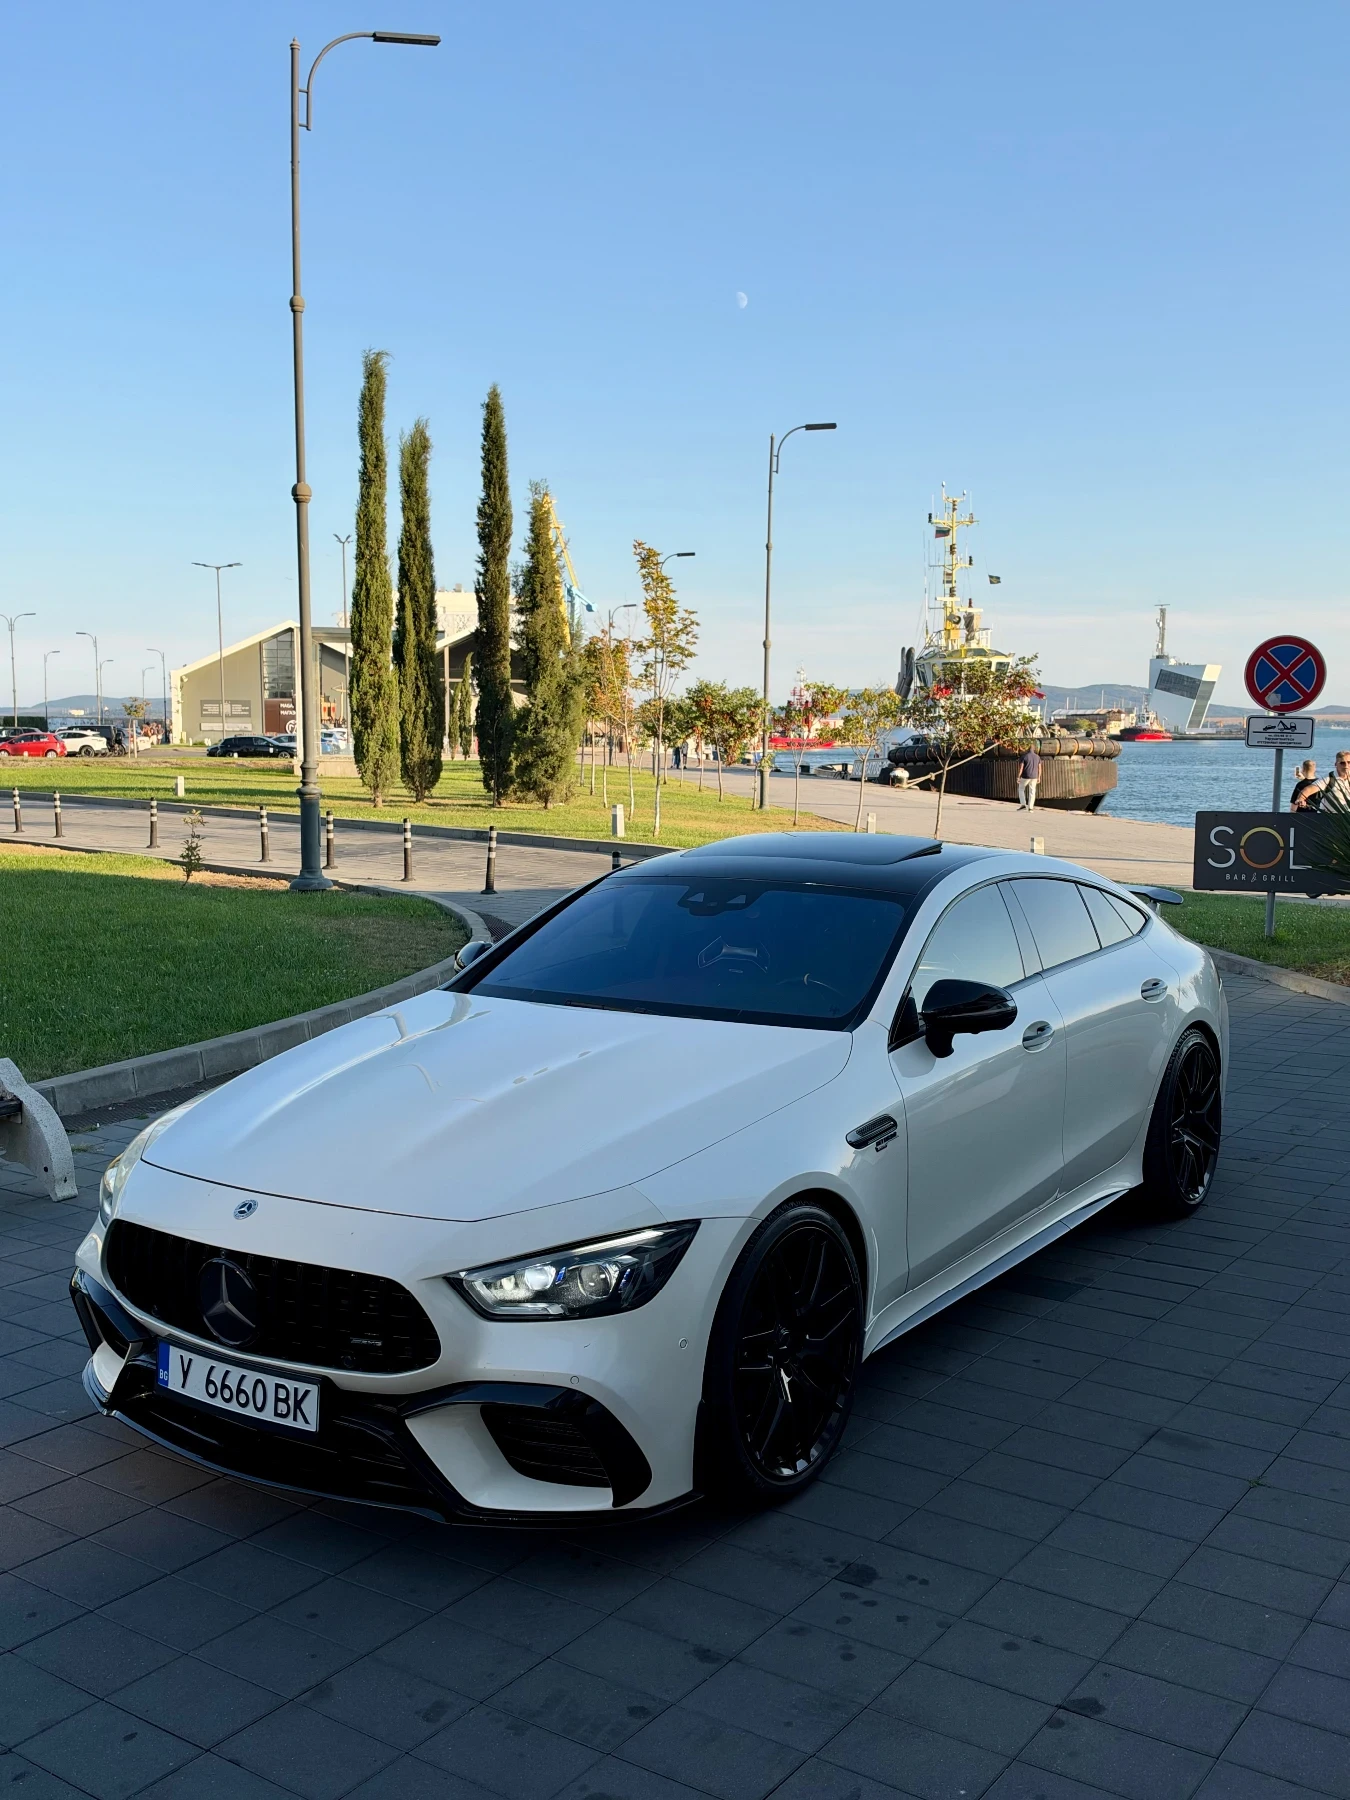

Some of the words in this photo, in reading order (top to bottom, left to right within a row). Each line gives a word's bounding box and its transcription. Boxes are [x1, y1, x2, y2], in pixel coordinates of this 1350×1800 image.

[1206, 825, 1313, 870] SOL
[1225, 873, 1247, 881] BAR
[1262, 874, 1296, 883] GRILL
[159, 1368, 169, 1381] BG
[204, 1365, 267, 1413] 6660
[273, 1382, 312, 1426] BK
